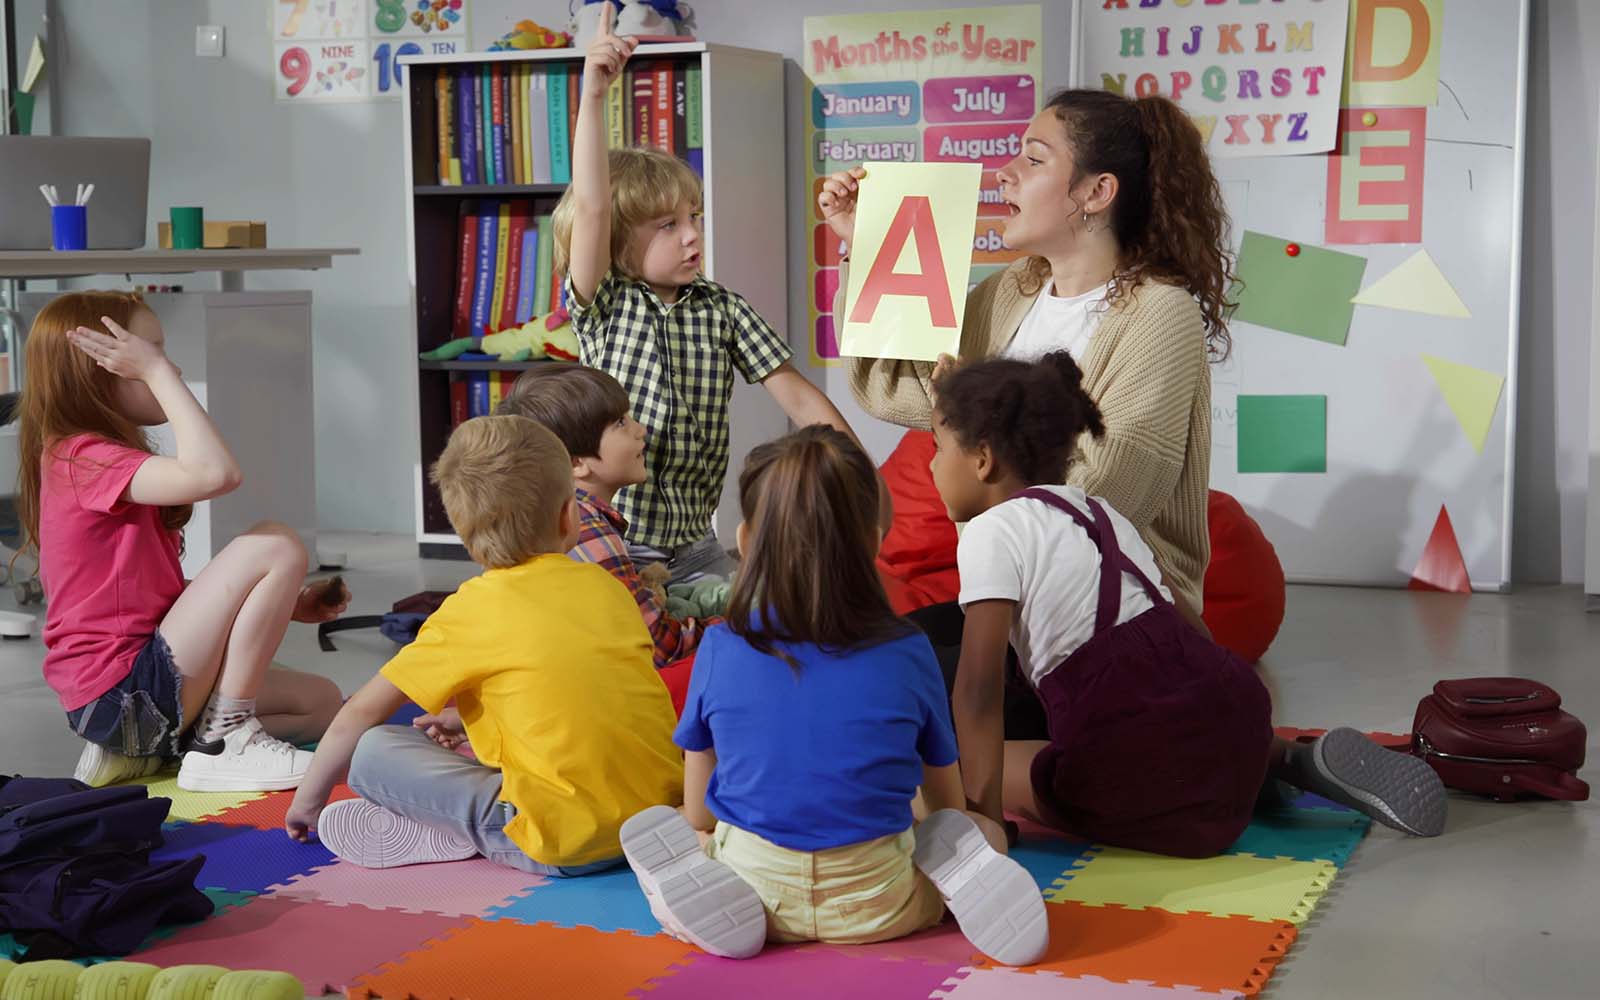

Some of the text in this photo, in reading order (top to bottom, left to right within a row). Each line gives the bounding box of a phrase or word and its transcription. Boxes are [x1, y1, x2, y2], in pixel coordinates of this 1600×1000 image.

[321, 46, 354, 58] NINE
[431, 43, 456, 55] TEN
[811, 22, 1036, 74] Months of the Year
[1352, 0, 1431, 82] D
[280, 47, 311, 95] 9
[676, 81, 684, 116] LAW
[823, 94, 911, 117] January
[952, 86, 1006, 114] July
[818, 139, 916, 161] February
[939, 133, 1022, 159] August
[1339, 130, 1410, 221] E
[848, 196, 957, 328] A
